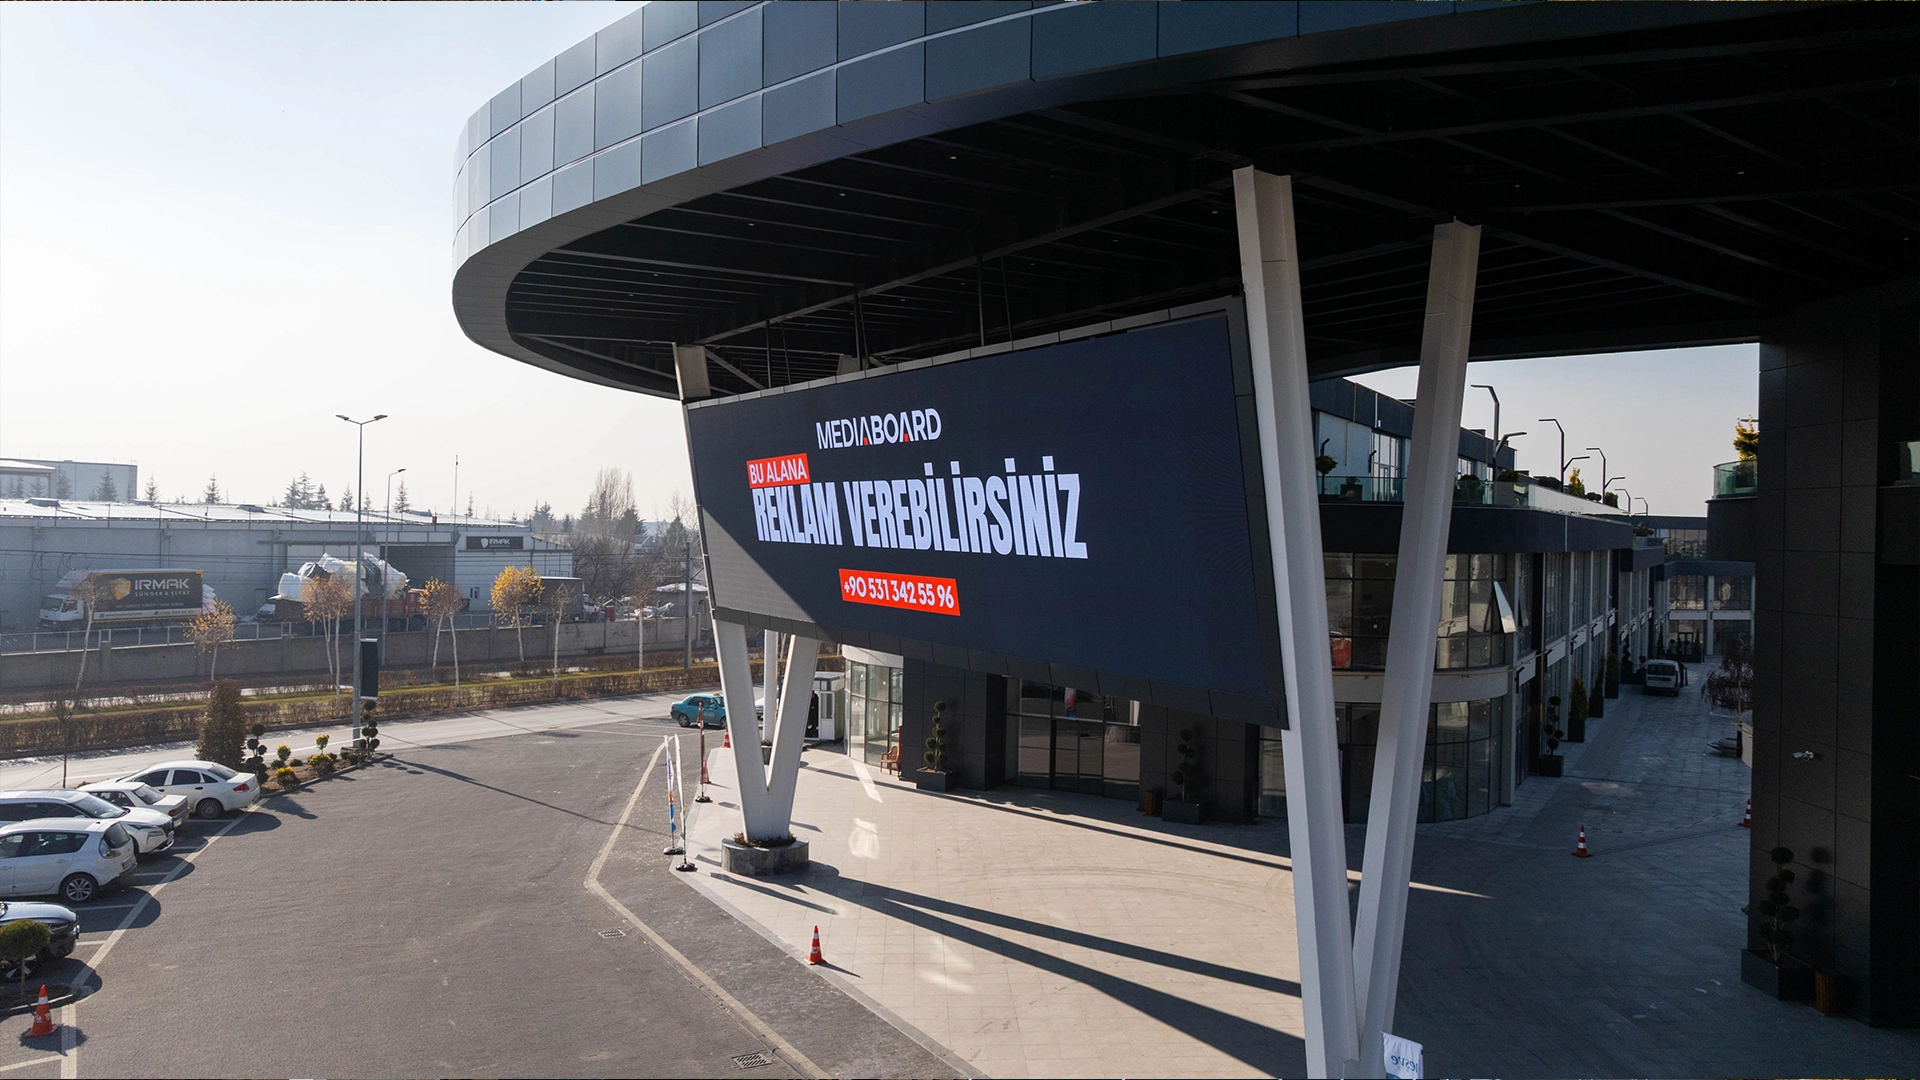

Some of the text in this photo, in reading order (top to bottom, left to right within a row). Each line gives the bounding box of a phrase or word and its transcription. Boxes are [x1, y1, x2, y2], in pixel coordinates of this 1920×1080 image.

[816, 408, 942, 450] MEDIABOARD
[749, 457, 808, 485] BU ALANA
[752, 455, 1088, 559] REKLAM VEREBİLİRSİNİZ
[135, 578, 189, 590] IRMAK
[844, 575, 955, 609] +90 531 342 55 96
